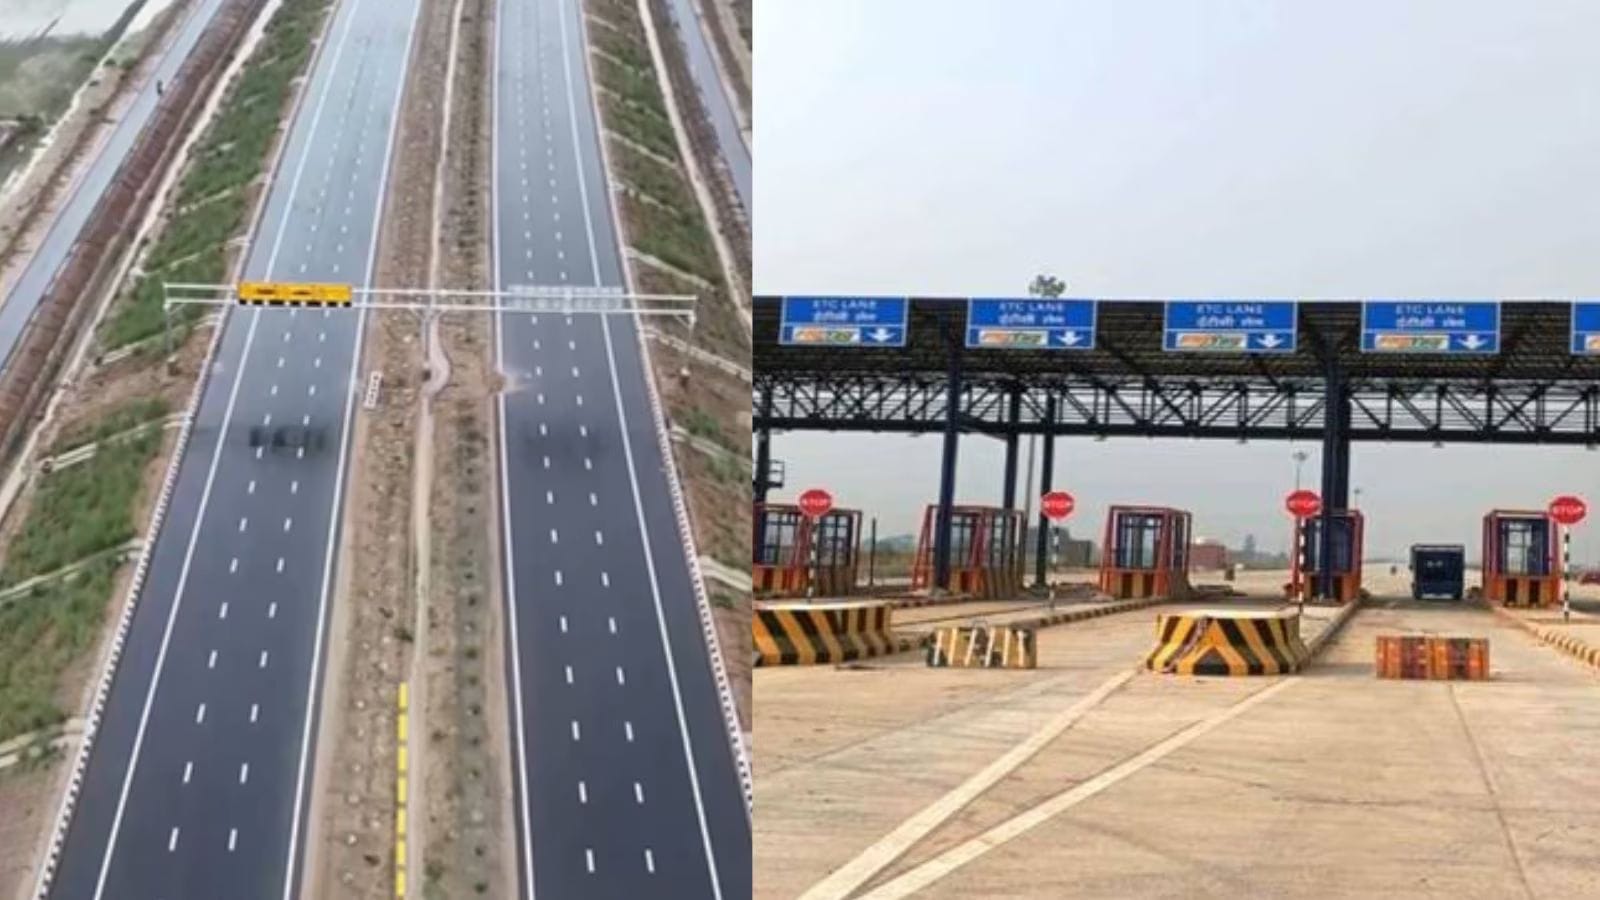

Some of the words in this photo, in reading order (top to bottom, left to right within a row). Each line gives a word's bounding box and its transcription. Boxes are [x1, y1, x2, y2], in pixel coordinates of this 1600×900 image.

[1226, 304, 1262, 314] LANE
[802, 498, 829, 506] STOP
[1043, 500, 1072, 509] STOP
[1289, 500, 1319, 508] STOP
[1552, 505, 1583, 515] STOP
